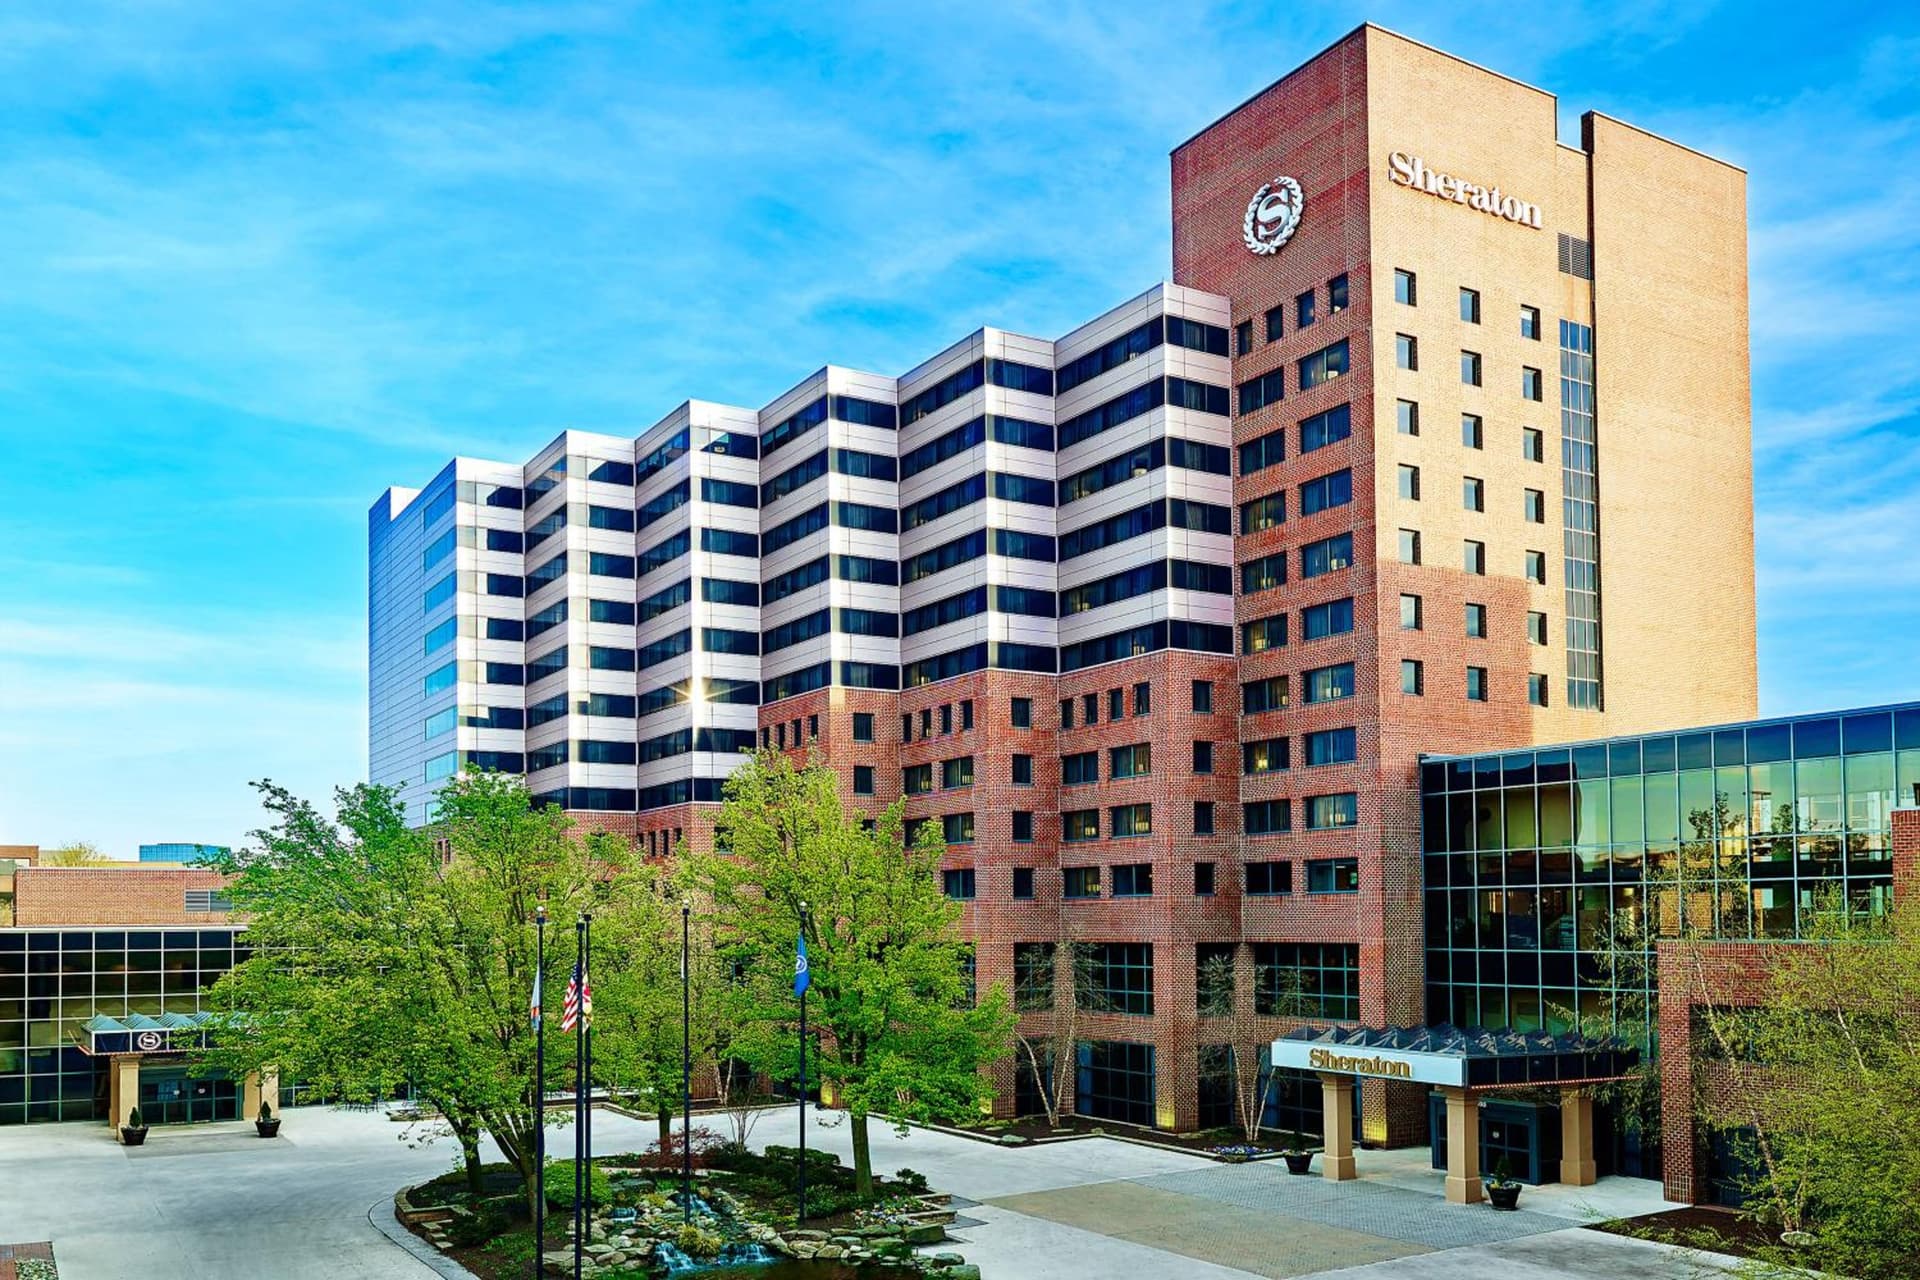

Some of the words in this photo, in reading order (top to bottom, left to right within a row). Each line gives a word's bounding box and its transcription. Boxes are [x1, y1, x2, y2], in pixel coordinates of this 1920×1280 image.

[1257, 188, 1290, 240] S
[1389, 151, 1543, 229] Sheraton
[1310, 1048, 1411, 1078] Sheraton
